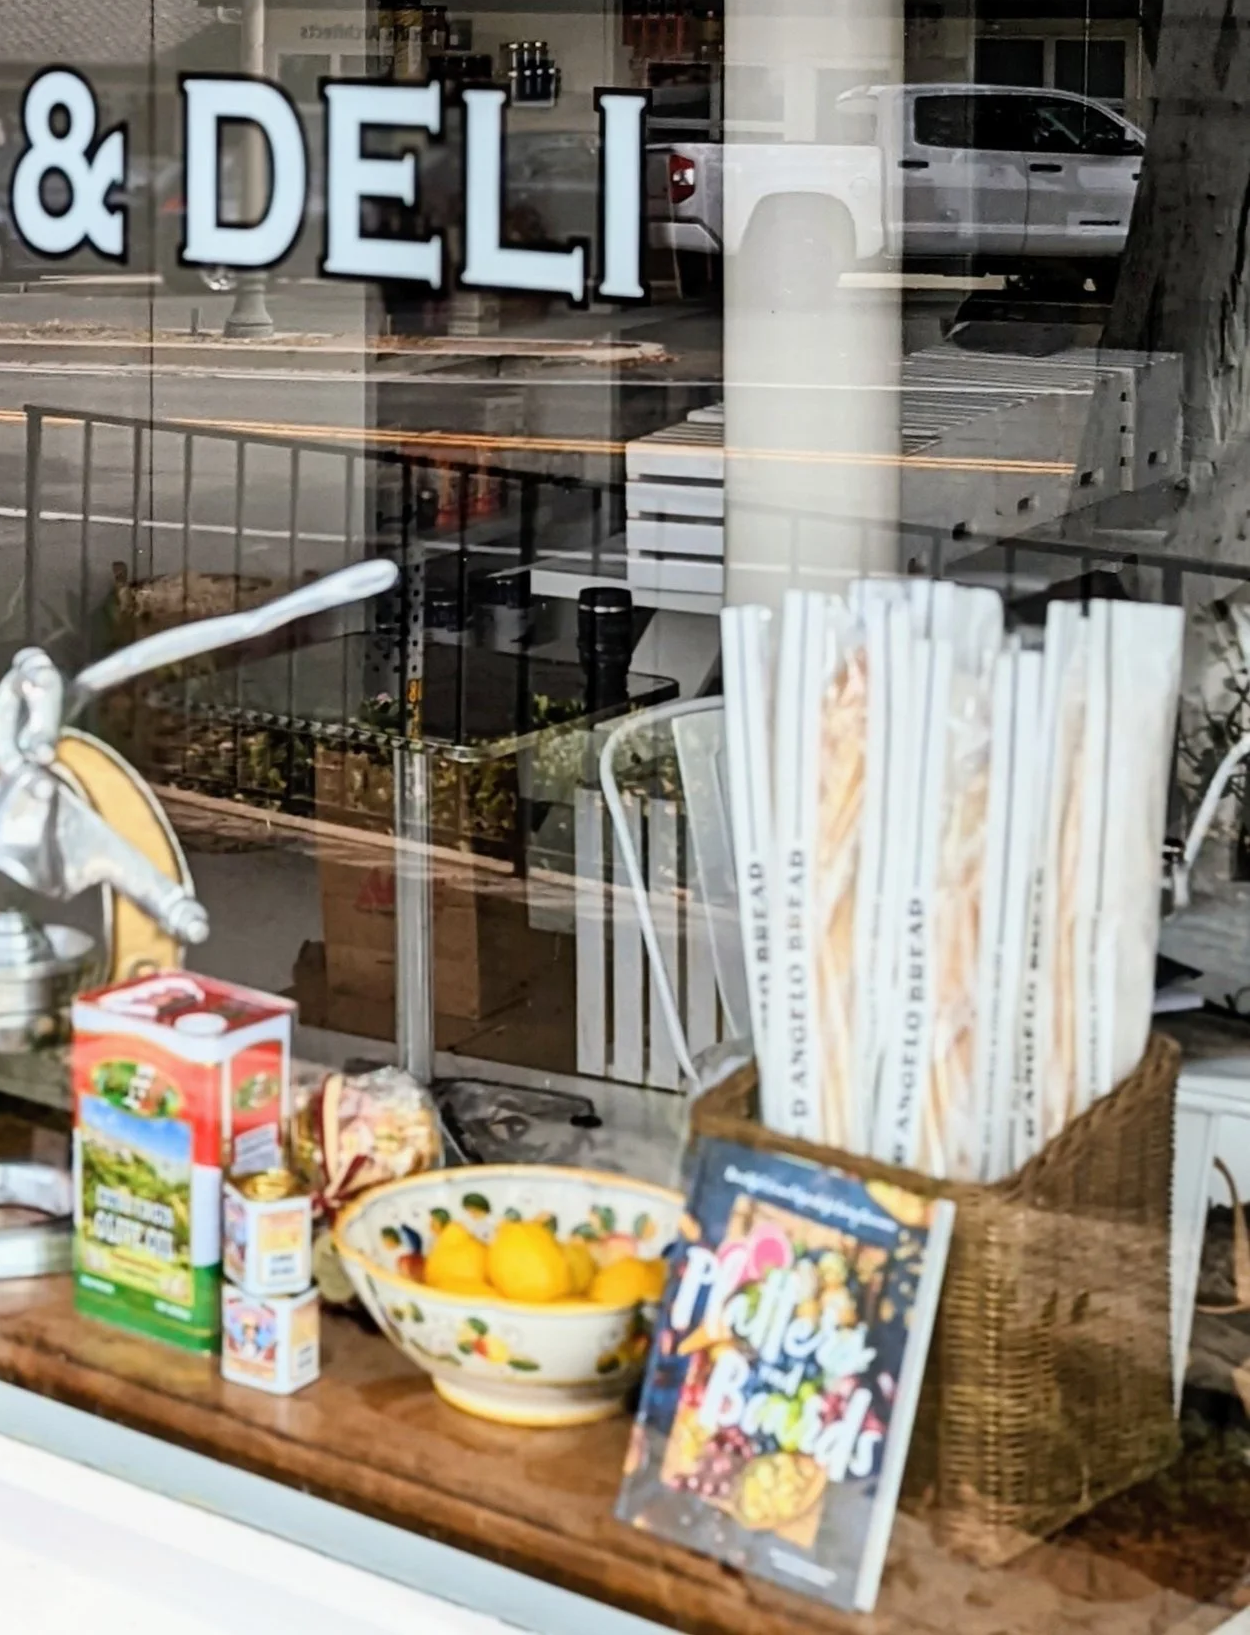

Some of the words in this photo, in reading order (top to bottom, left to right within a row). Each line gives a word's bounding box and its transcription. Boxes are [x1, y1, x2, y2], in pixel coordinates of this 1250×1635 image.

[10, 63, 129, 265] &
[178, 72, 653, 307] DELI
[907, 899, 924, 1002] BREAD
[699, 1348, 882, 1483] Boards
